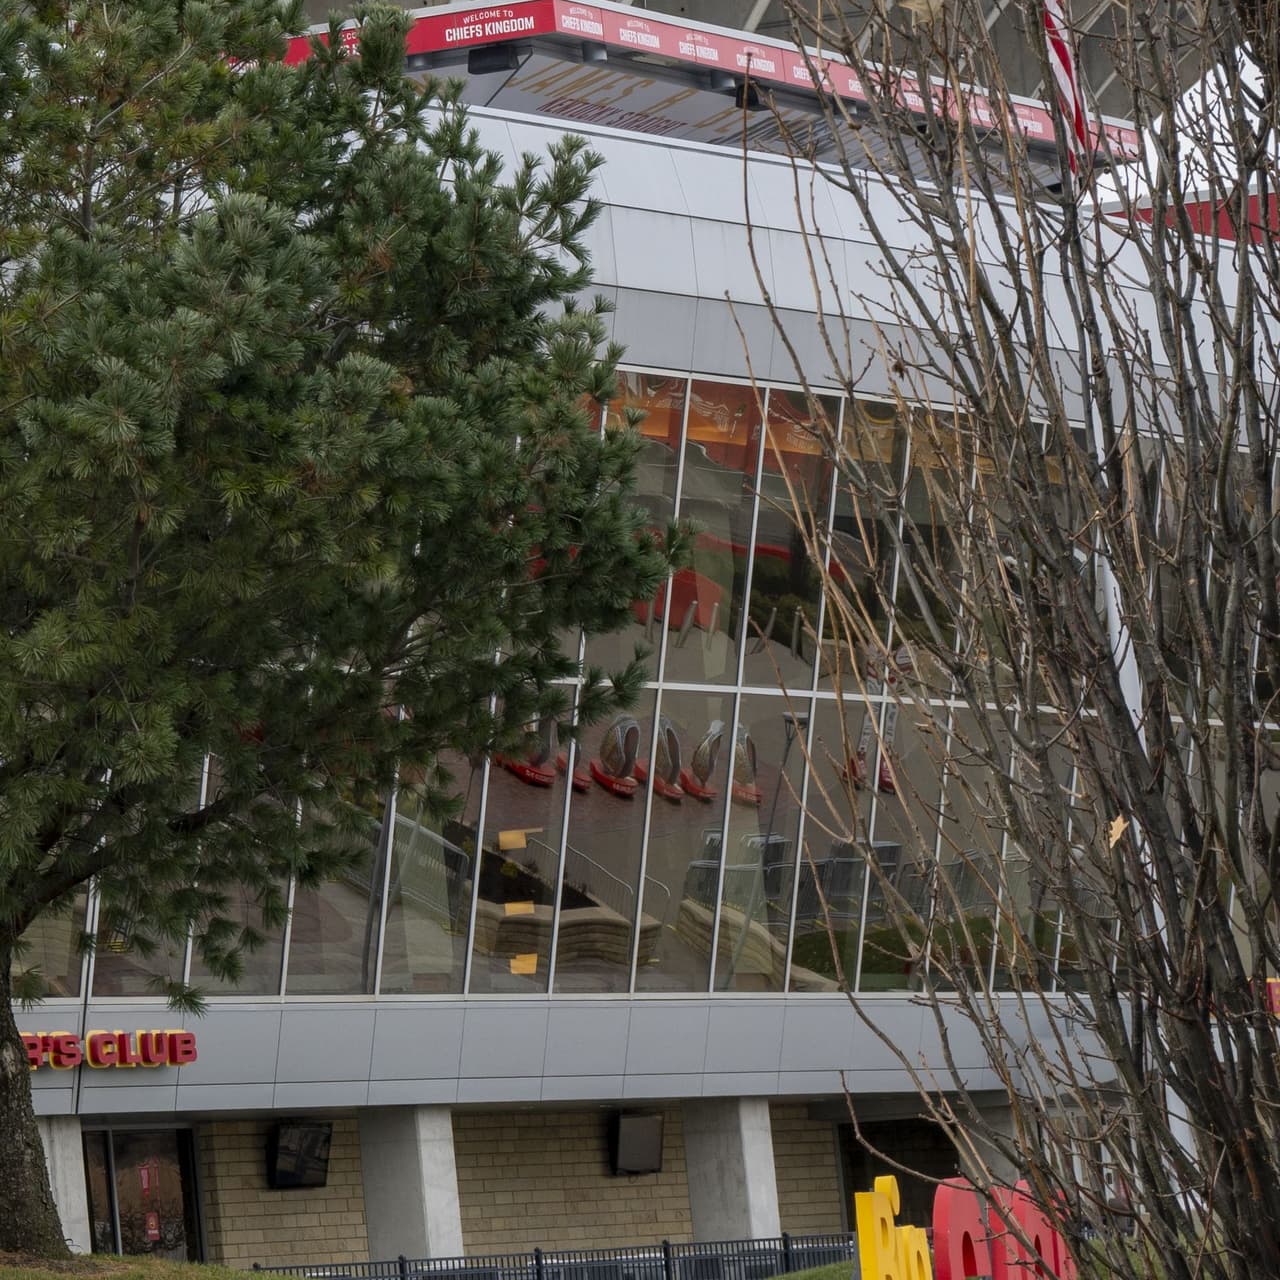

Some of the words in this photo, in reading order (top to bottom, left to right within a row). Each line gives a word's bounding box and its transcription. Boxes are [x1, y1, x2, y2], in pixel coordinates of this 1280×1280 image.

[445, 24, 482, 42] CHIEFS
[485, 16, 534, 35] KINGDOM
[463, 10, 501, 24] WELCOME
[87, 1029, 198, 1069] CLUB
